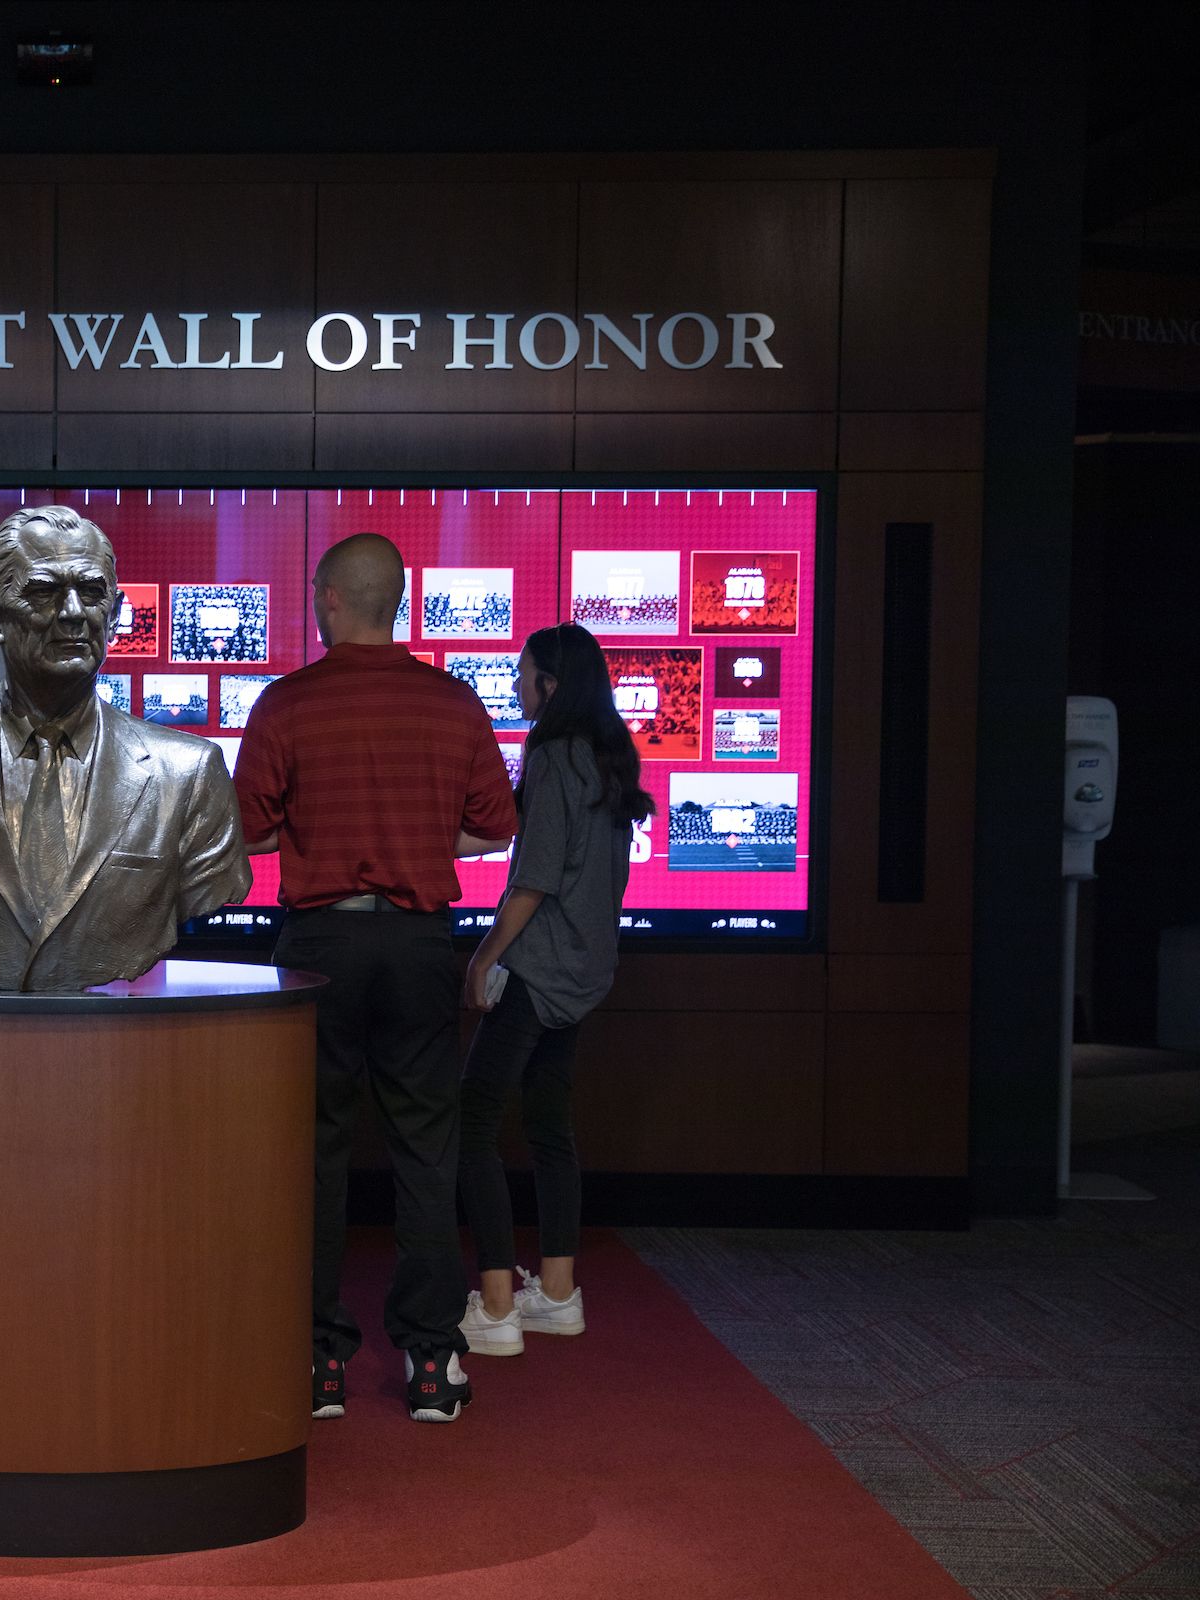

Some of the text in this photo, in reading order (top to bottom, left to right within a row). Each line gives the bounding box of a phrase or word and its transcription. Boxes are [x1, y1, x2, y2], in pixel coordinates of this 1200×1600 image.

[48, 312, 284, 371] WALL
[306, 312, 421, 372] OF
[445, 312, 784, 371] HONOR
[225, 914, 254, 924] PLAYERS
[729, 918, 758, 928] PLAYERS
